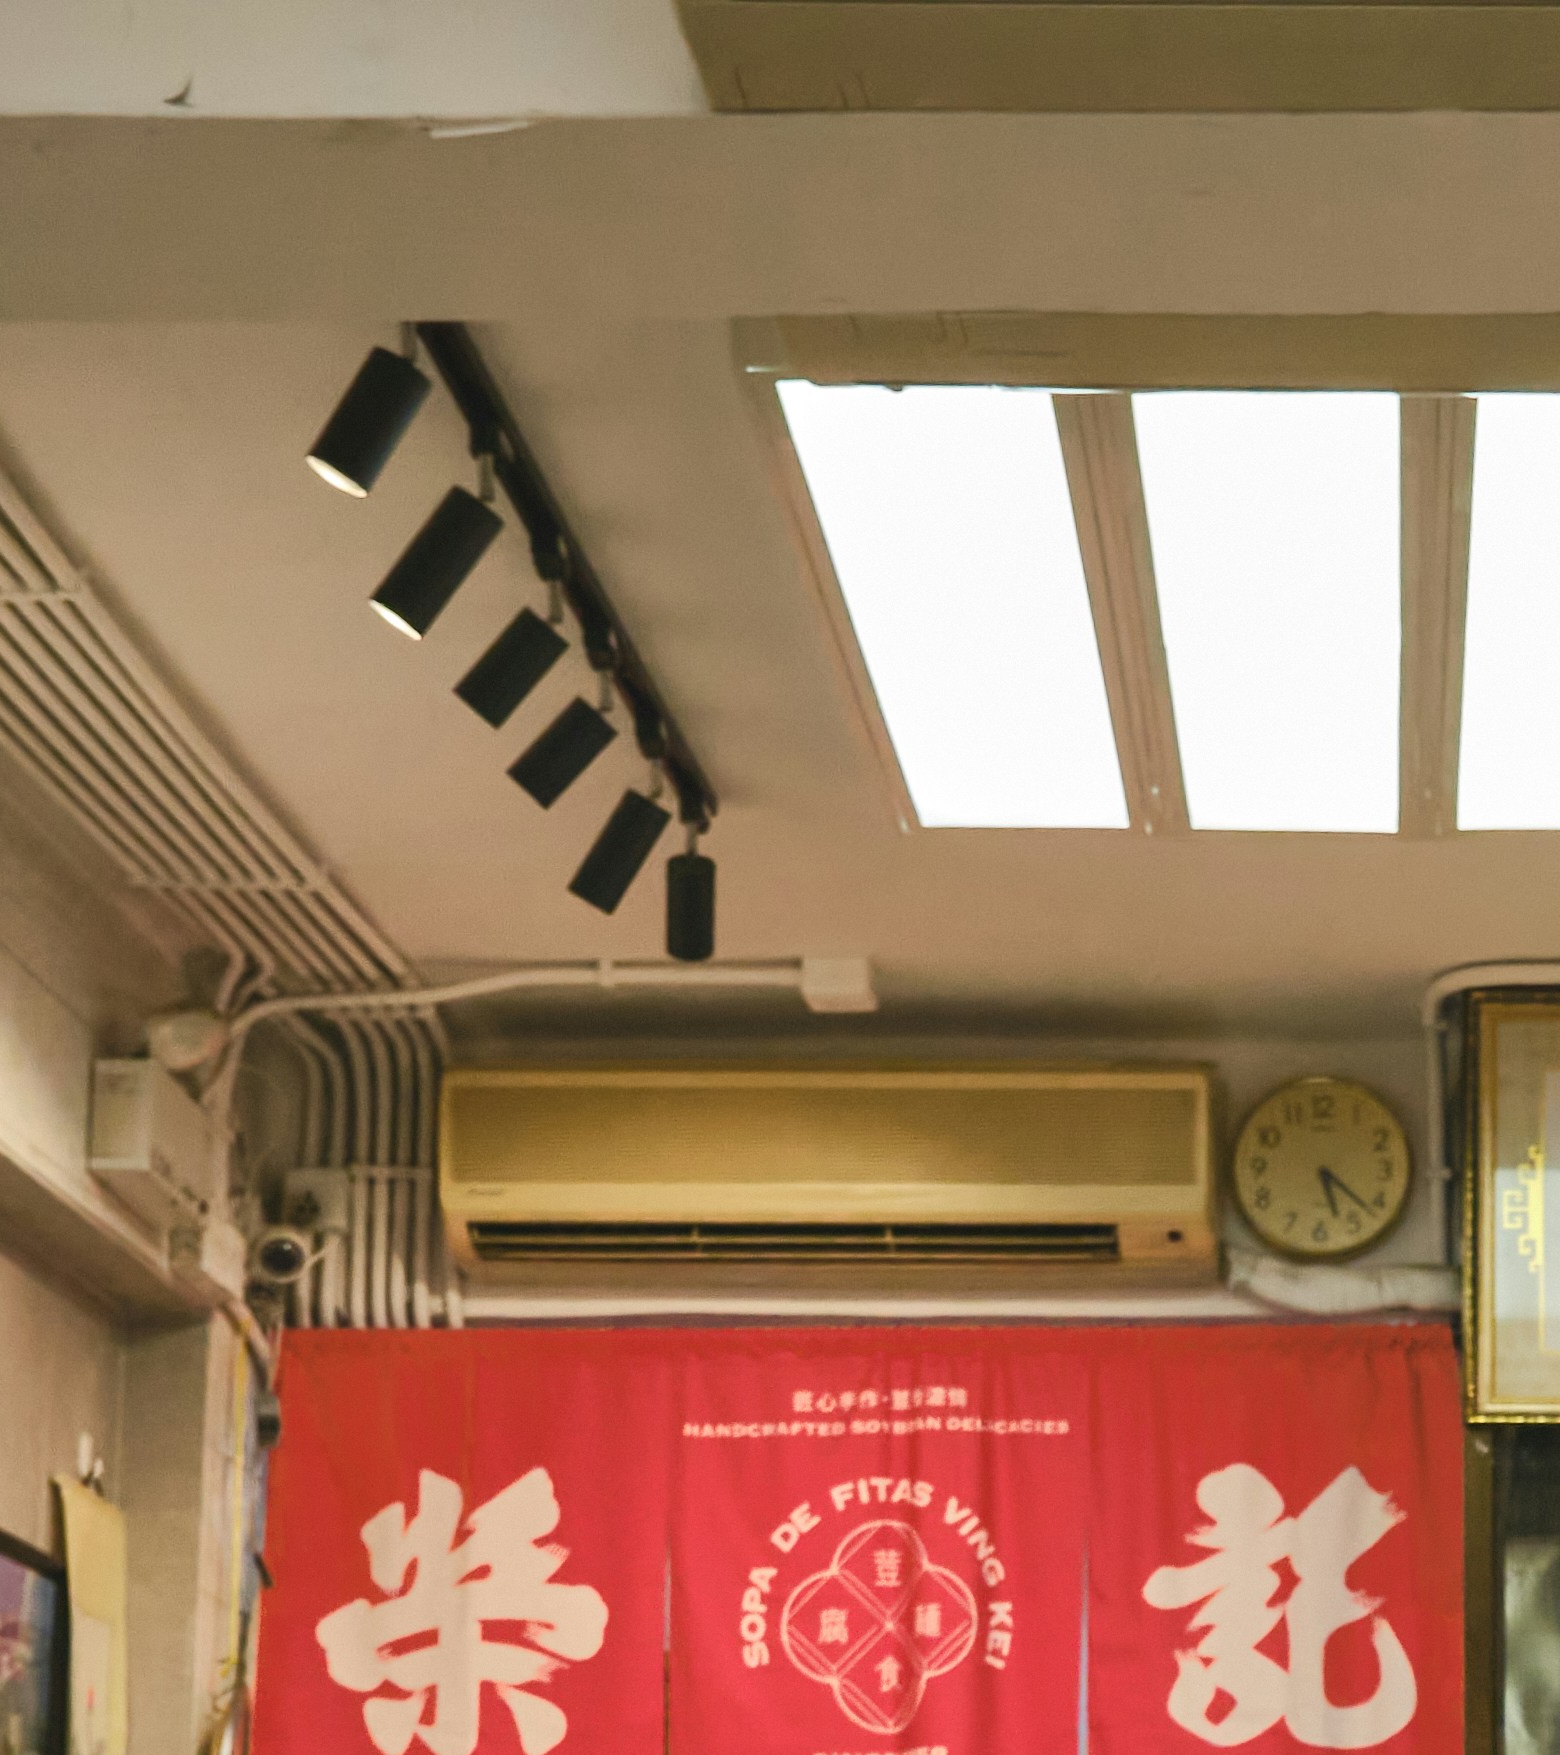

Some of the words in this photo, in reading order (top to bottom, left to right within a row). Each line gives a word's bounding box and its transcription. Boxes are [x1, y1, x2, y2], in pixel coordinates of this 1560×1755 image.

[682, 1420, 846, 1438] HANDCRAFTED
[740, 1565, 778, 1669] SOPA
[770, 1501, 823, 1553] DE
[829, 1476, 935, 1512] FITAS
[943, 1496, 1007, 1588] VING
[984, 1600, 1015, 1671] KEI
